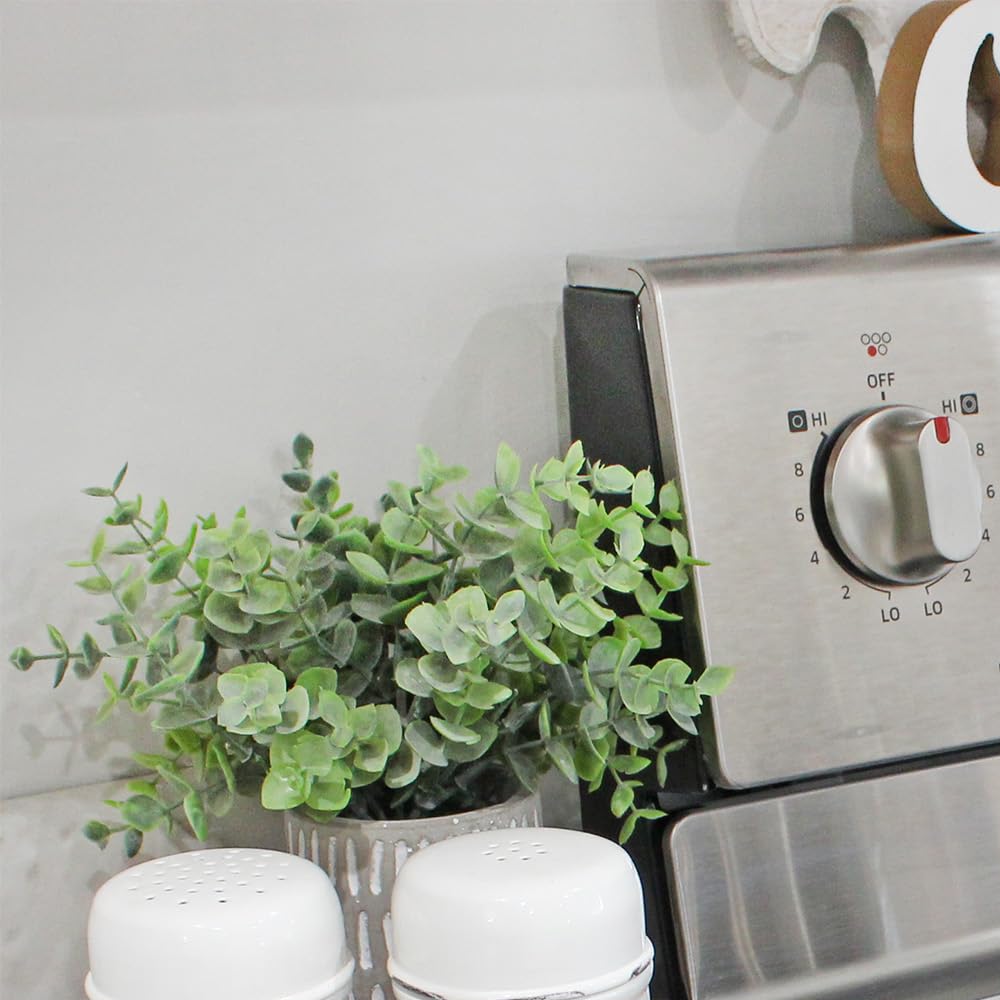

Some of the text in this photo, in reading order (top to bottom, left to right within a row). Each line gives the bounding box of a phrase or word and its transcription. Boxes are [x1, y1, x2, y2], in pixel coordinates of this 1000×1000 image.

[867, 372, 895, 389] OFF
[942, 399, 957, 414] HI
[811, 411, 828, 427] HI
[975, 442, 985, 457] 8
[794, 462, 804, 477] 8
[986, 484, 995, 499] 6
[795, 507, 804, 523] 6
[981, 528, 990, 542] 4
[810, 551, 819, 565] 4
[963, 568, 972, 583] 2
[841, 585, 851, 600] 2
[881, 607, 900, 623] LO
[924, 600, 943, 617] LO
